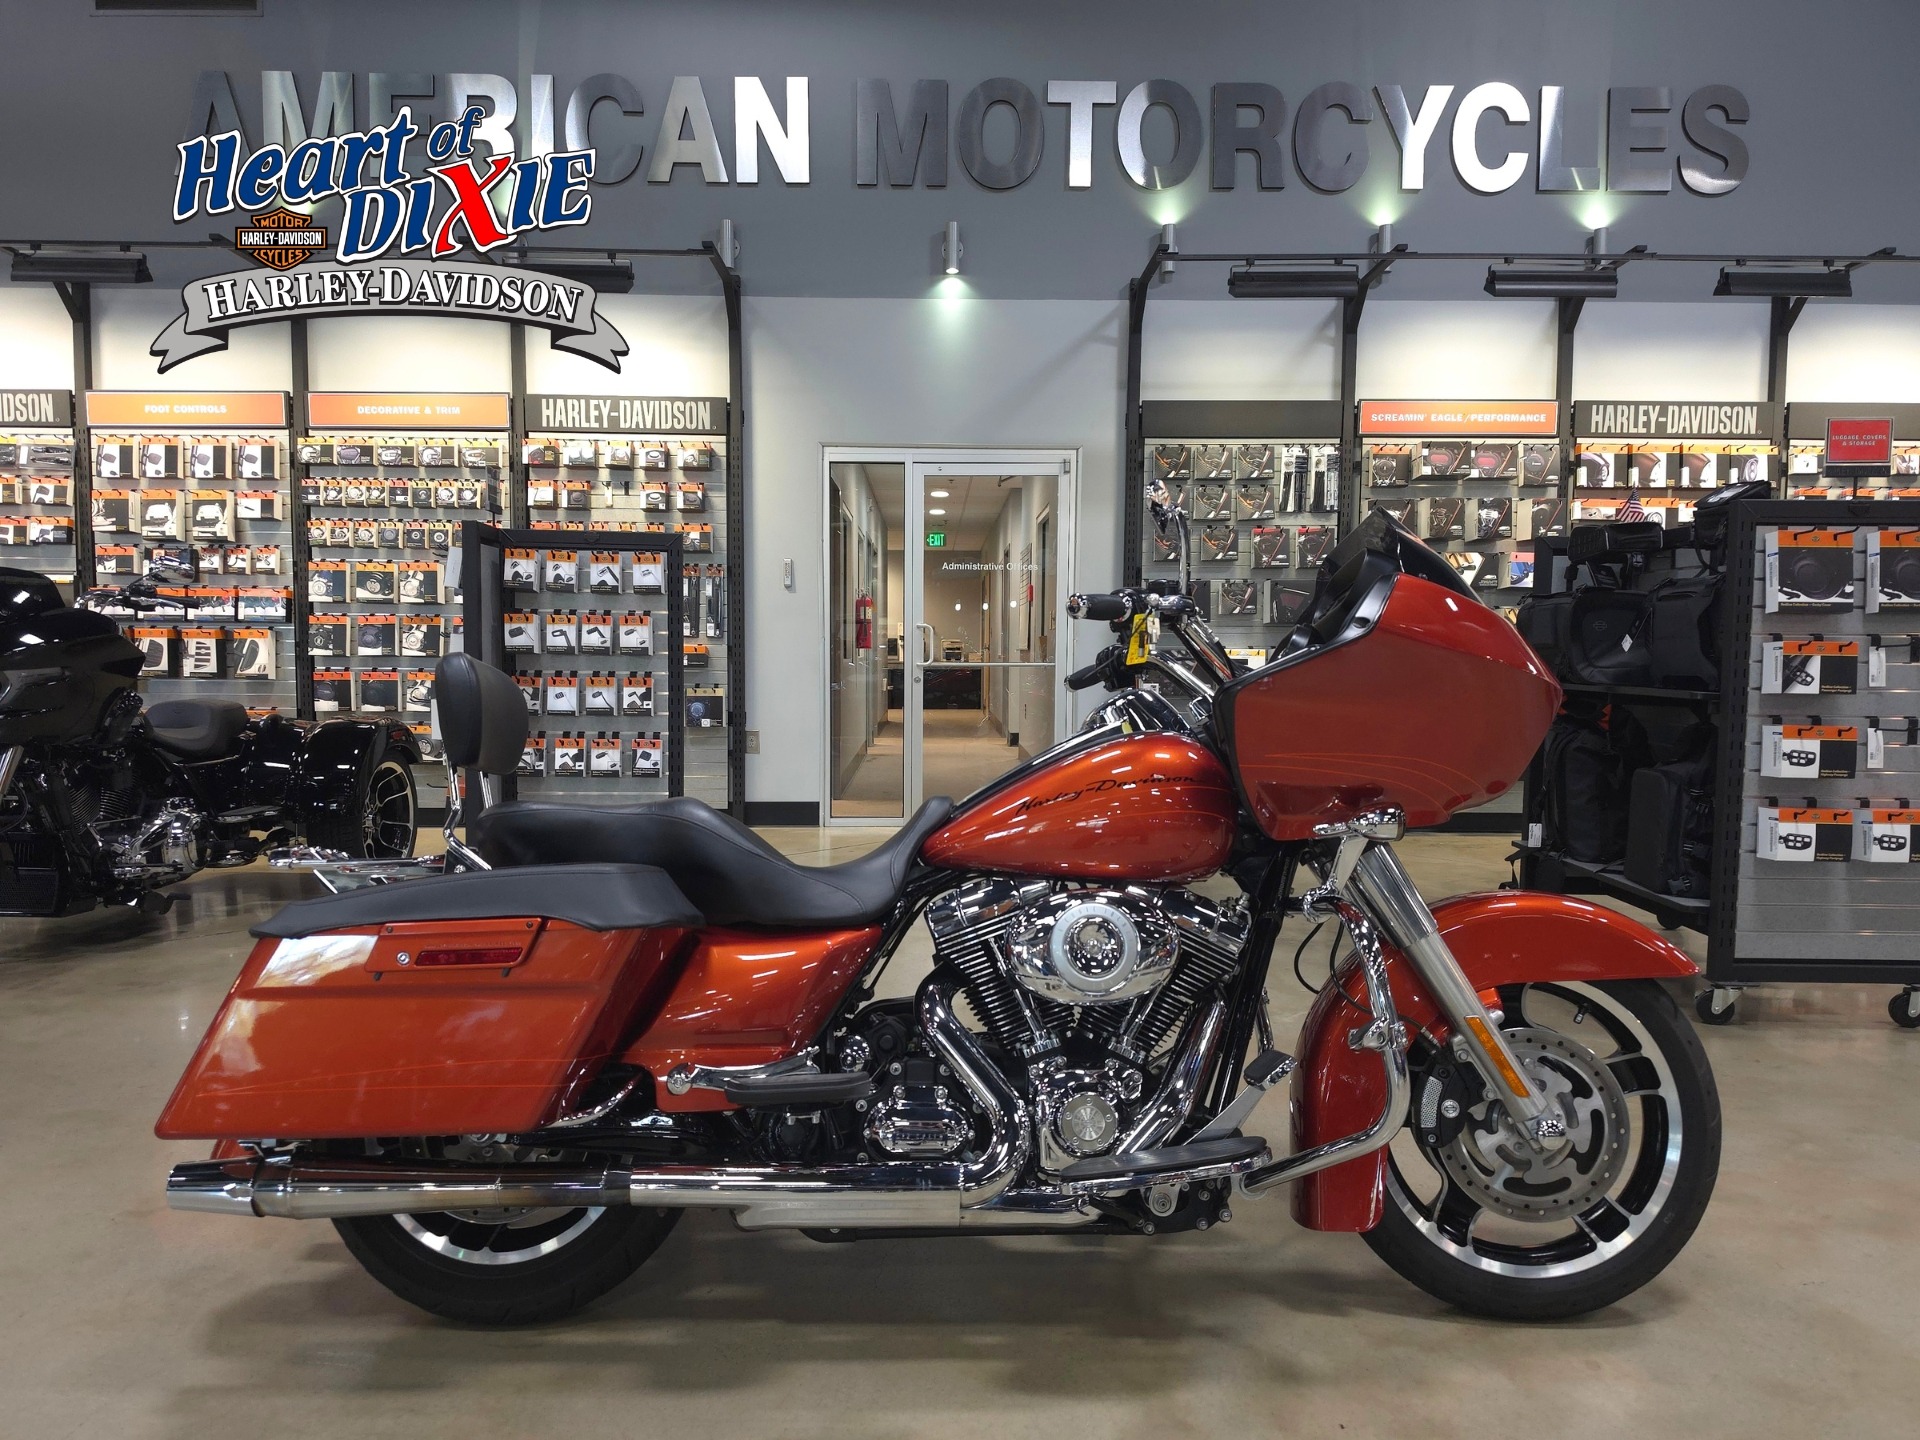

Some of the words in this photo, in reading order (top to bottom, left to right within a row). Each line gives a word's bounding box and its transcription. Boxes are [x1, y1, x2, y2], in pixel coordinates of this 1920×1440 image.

[174, 70, 811, 185] AMERICAN
[855, 77, 1751, 195] MOTORCYCLES
[144, 404, 171, 414] FOOT
[173, 404, 228, 414] CONTROLS
[357, 405, 421, 415] DECORATIVE
[424, 405, 432, 415] &
[435, 405, 461, 415] TRIM
[541, 398, 711, 430] HARLEY-DAVIDSON
[1590, 404, 1758, 435] HARLEY-DAVIDSON
[929, 533, 945, 546] EXIT
[942, 562, 1004, 571] Administrative
